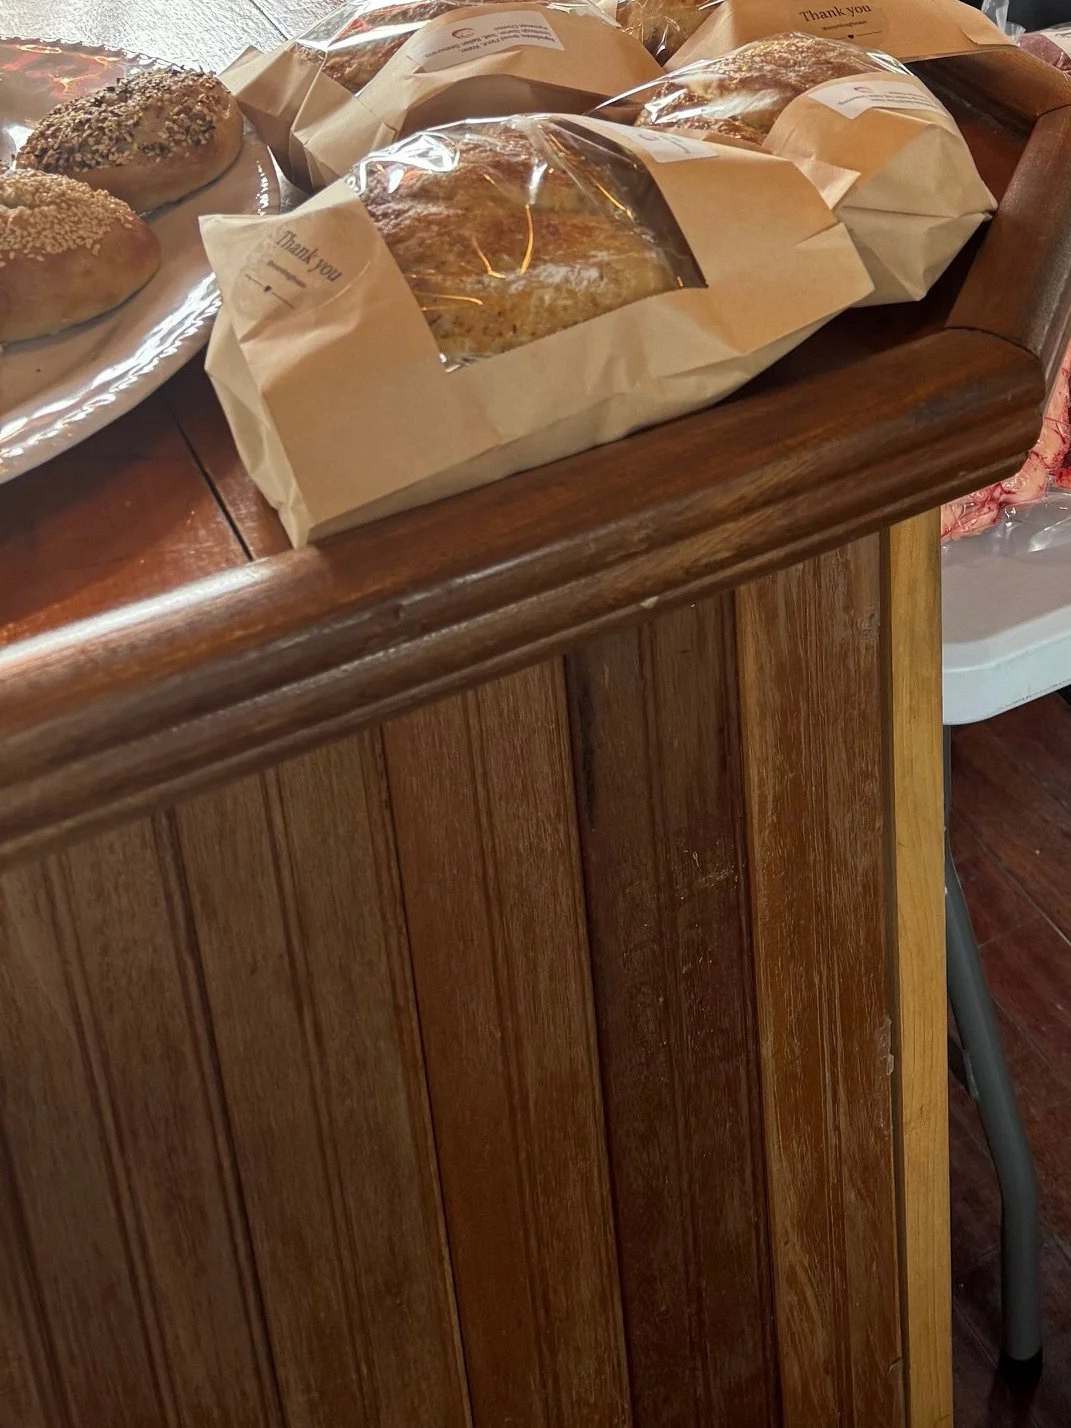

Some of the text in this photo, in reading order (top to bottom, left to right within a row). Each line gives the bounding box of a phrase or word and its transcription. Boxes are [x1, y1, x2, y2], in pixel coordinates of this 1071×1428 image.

[799, 4, 872, 22] Thank you
[276, 230, 319, 264] Thank
[307, 259, 342, 282] you
